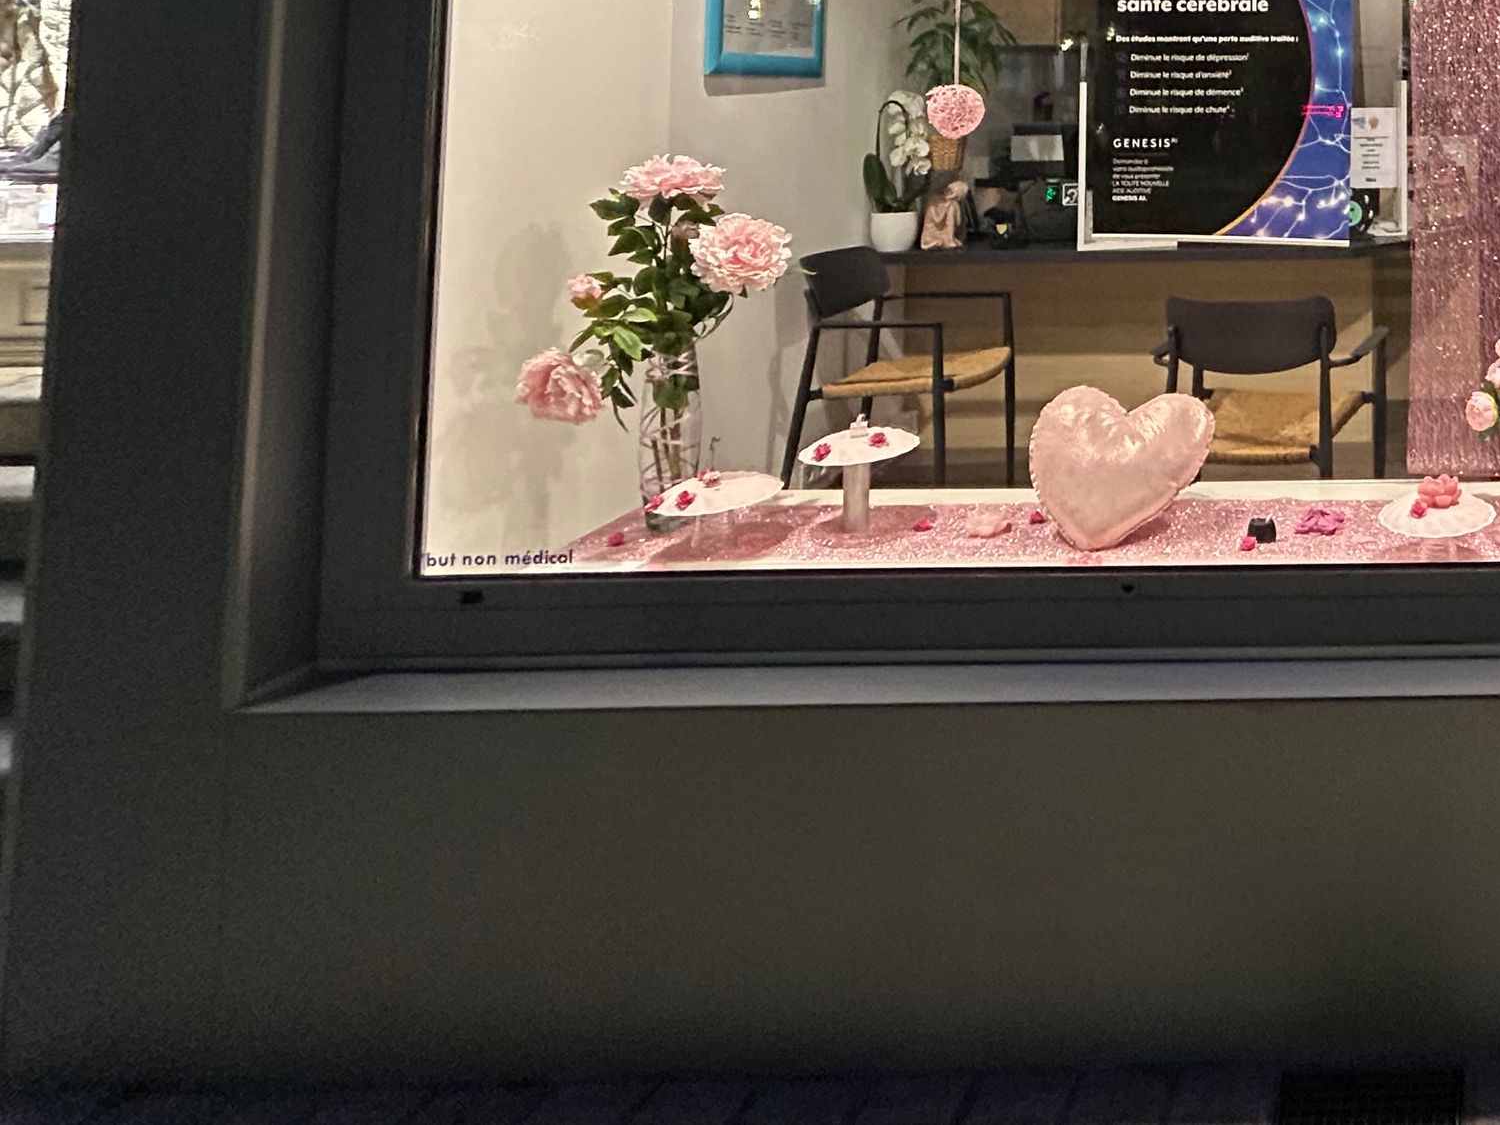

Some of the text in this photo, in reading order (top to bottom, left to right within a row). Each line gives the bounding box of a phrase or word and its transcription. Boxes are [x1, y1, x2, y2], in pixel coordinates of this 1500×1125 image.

[1115, 35, 1130, 43] Des
[1130, 35, 1156, 43] études
[1218, 35, 1239, 44] perte
[1239, 35, 1270, 43] auditive
[1130, 53, 1162, 62] Diminue
[1162, 53, 1170, 62] le
[1170, 53, 1195, 63] risque
[1195, 53, 1206, 62] de
[1130, 71, 1161, 79] Diminue
[1162, 71, 1170, 79] le
[1170, 71, 1194, 80] risque
[1129, 88, 1161, 96] Diminue
[1162, 88, 1169, 96] le
[1170, 88, 1194, 98] risque
[1194, 88, 1205, 96] de
[1128, 105, 1161, 114] Diminue
[1161, 105, 1169, 114] le
[1169, 106, 1193, 115] risque
[1194, 105, 1204, 114] de
[426, 548, 574, 568] but non médical
